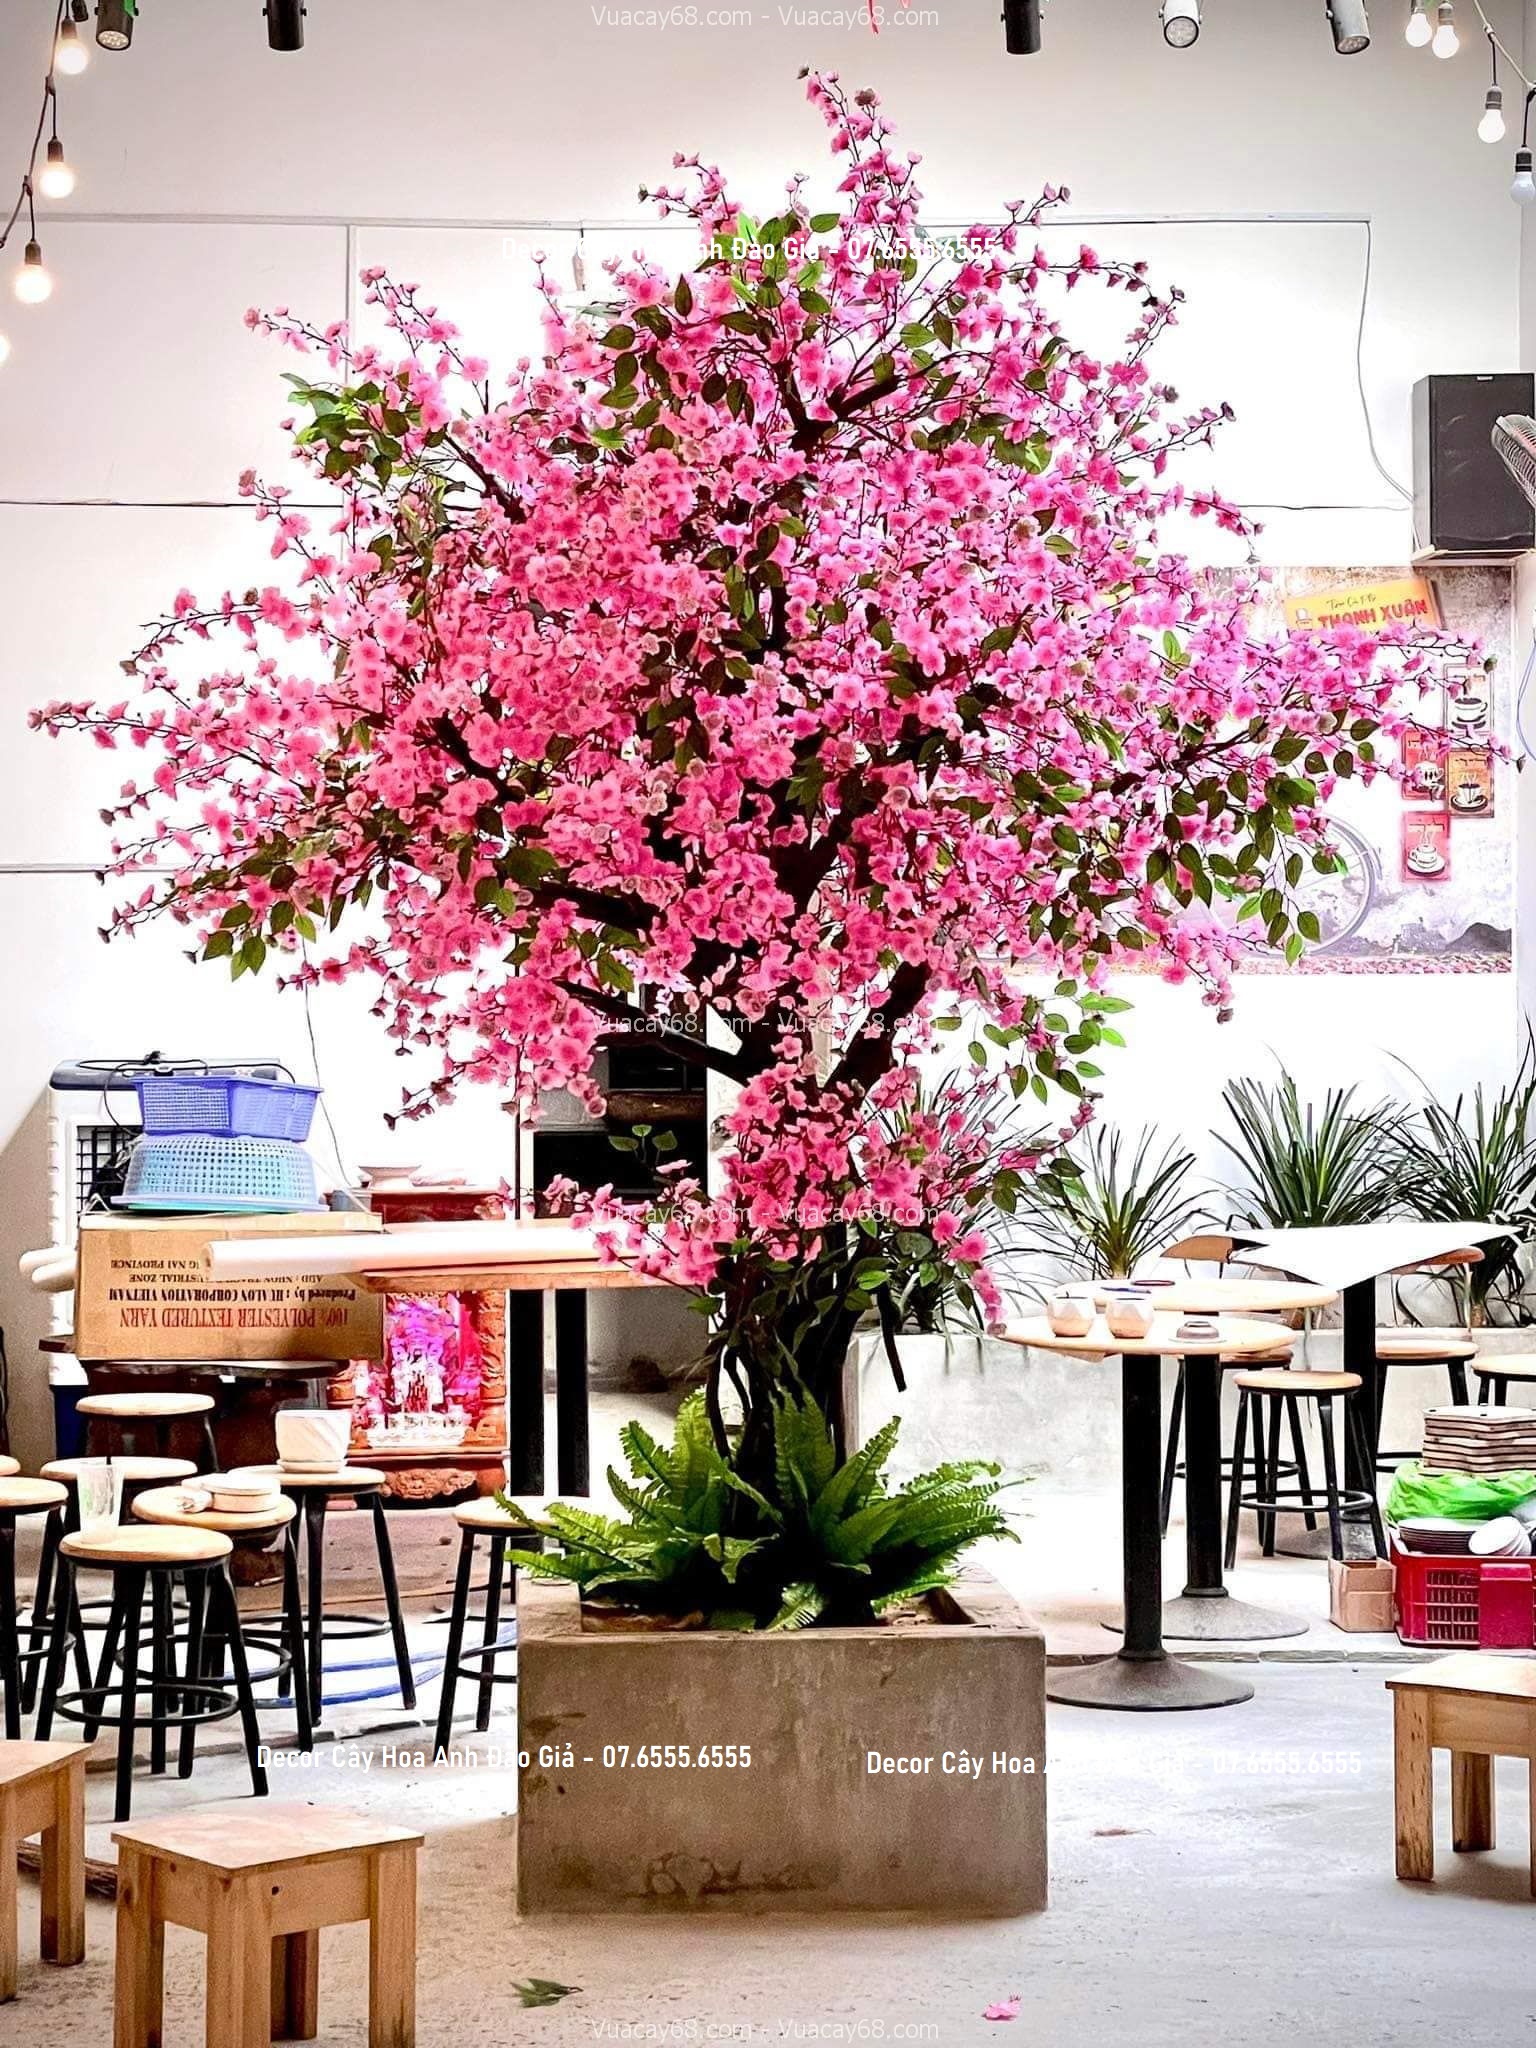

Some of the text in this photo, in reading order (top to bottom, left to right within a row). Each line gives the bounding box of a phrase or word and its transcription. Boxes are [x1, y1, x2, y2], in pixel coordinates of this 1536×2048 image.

[110, 1259, 164, 1269] PROVINCE
[167, 1260, 186, 1269] NAI
[128, 1274, 157, 1283] ZONE
[109, 1288, 157, 1301] VIETNAM
[161, 1289, 238, 1302] CORPORATION
[307, 1289, 356, 1301] Produced
[120, 1308, 157, 1328] YARN
[161, 1308, 234, 1328] TEXTURED
[238, 1308, 316, 1328] POLYESTER
